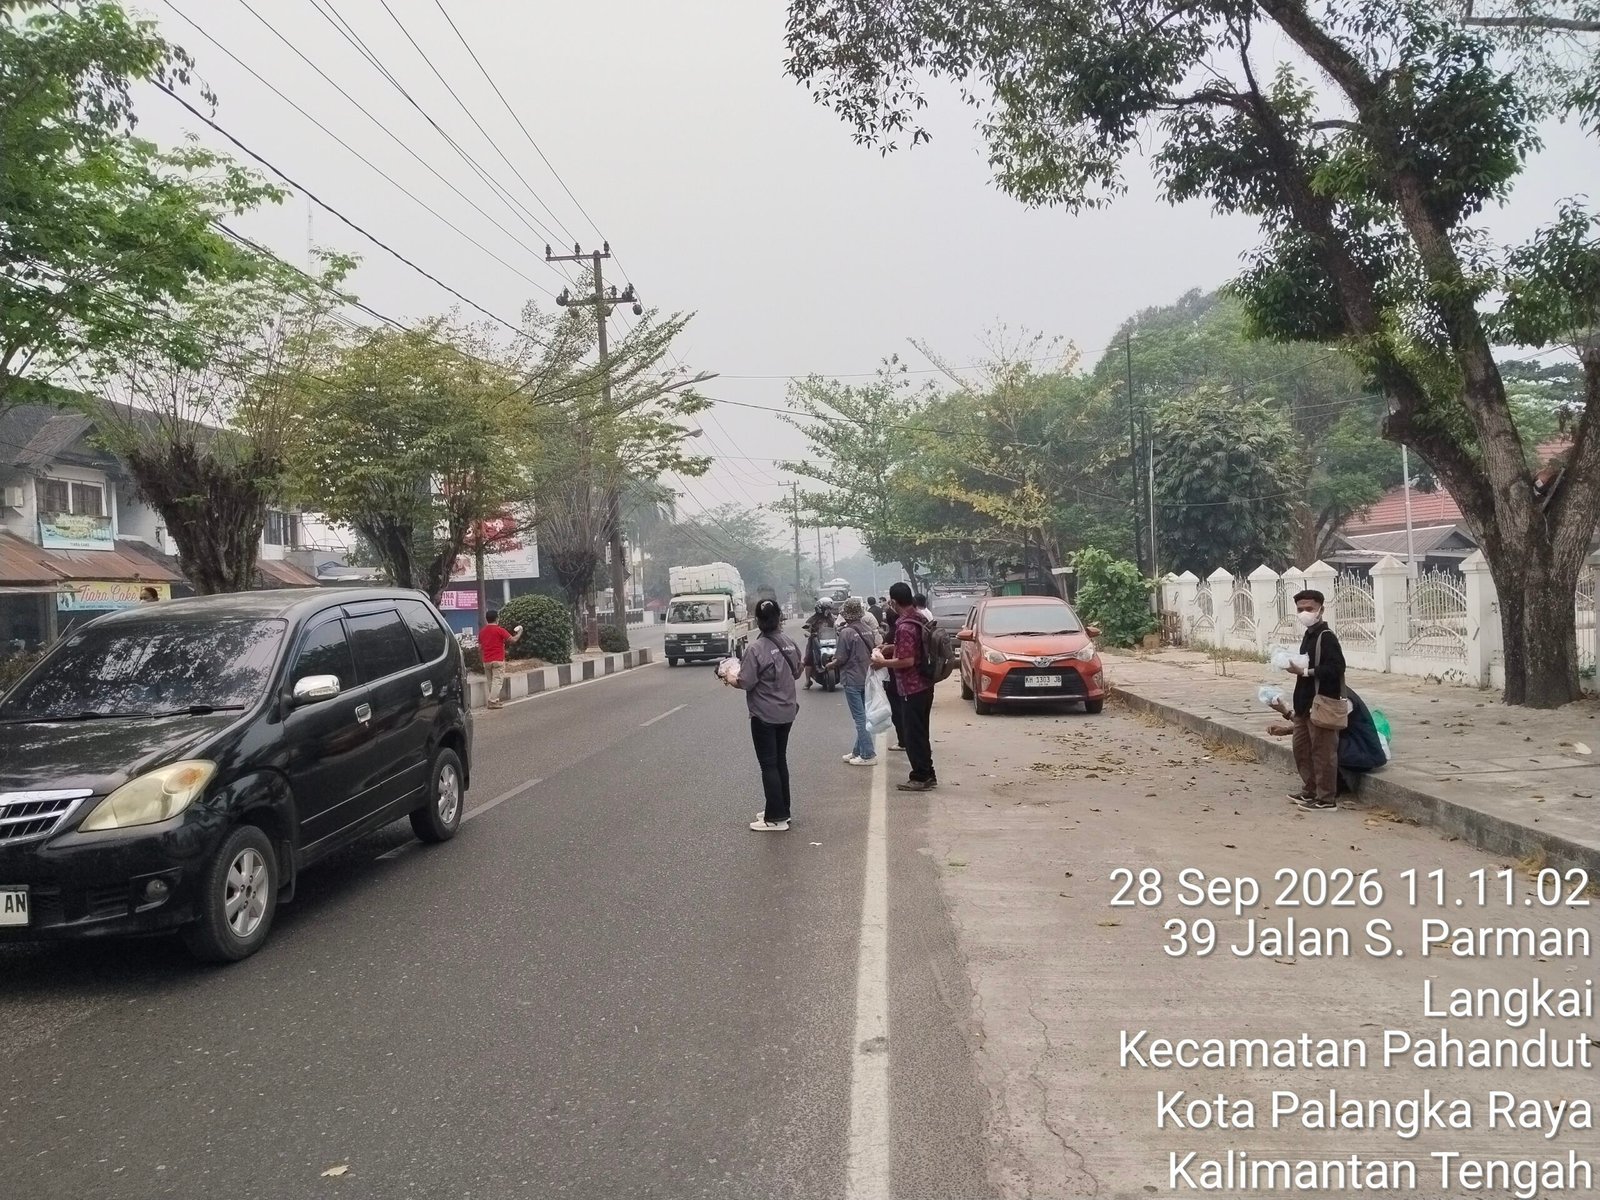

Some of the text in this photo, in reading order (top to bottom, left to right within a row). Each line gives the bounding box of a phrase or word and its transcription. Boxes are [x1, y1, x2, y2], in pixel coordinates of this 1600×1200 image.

[79, 584, 109, 602] Tiara
[111, 584, 137, 603] Cake
[5, 894, 26, 913] AN
